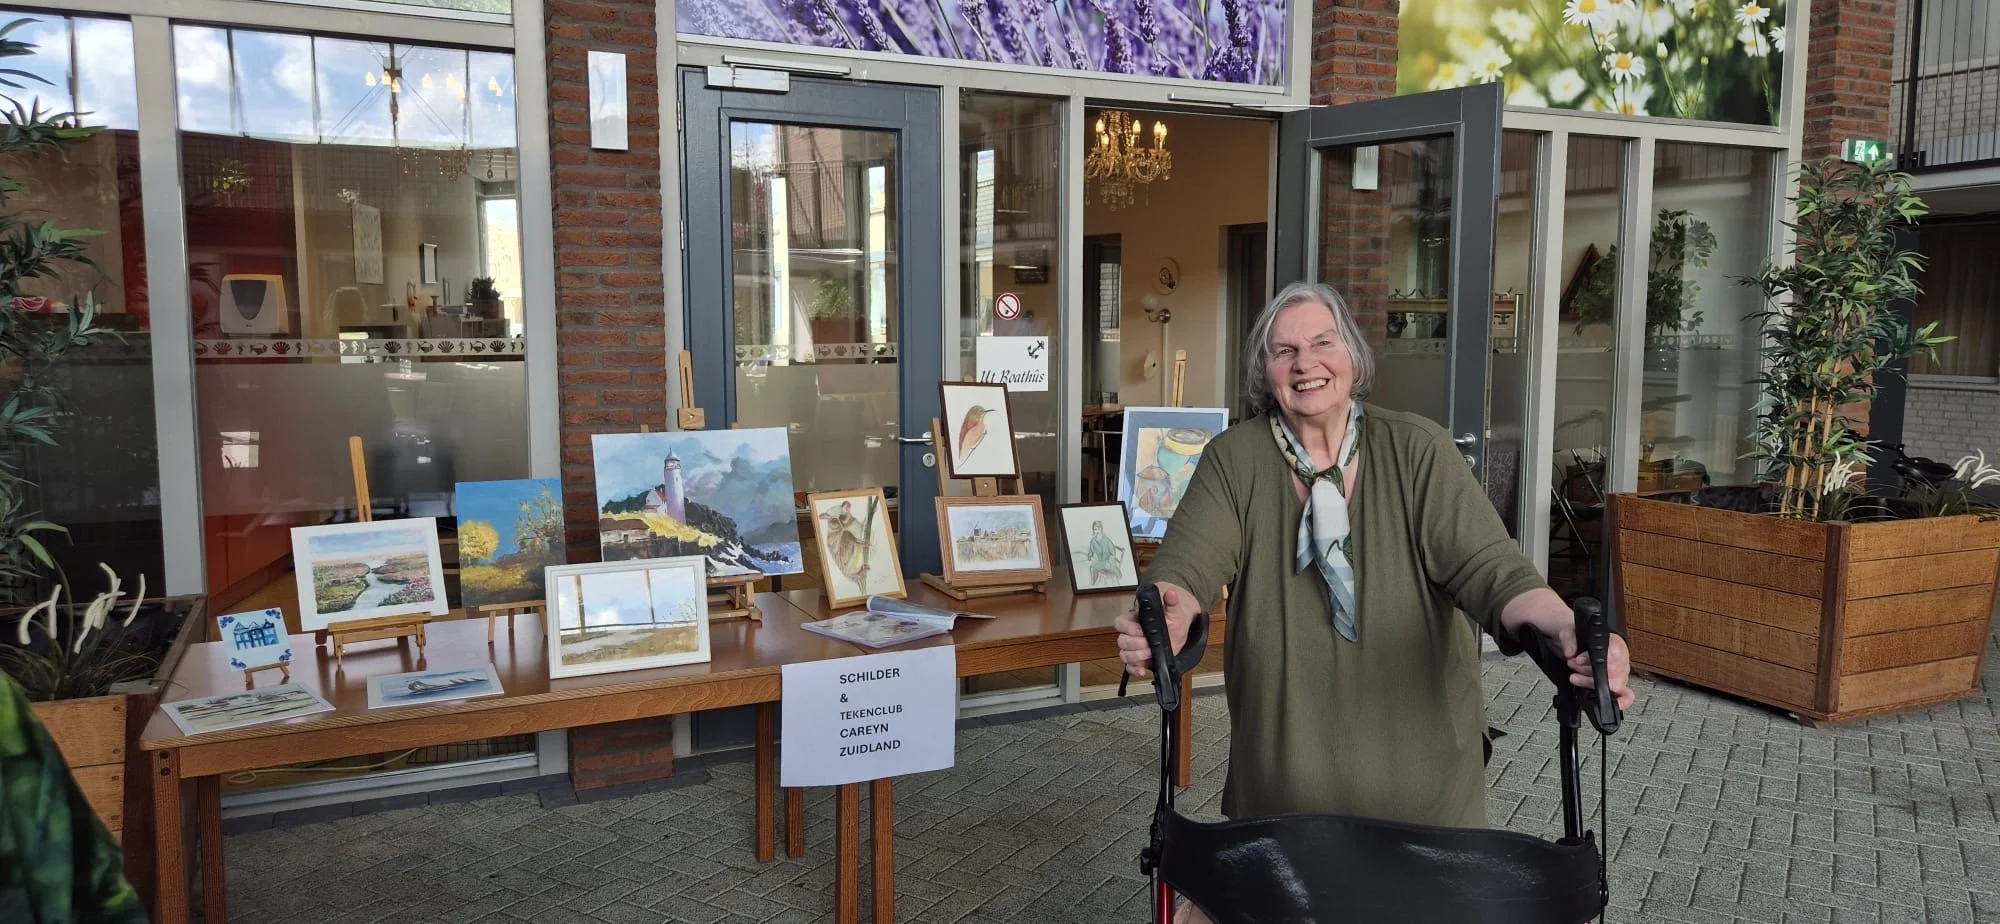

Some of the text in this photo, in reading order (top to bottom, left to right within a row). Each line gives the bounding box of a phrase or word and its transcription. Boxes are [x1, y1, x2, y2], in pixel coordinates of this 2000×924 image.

[839, 668, 900, 684] SCHILDER
[840, 693, 848, 703] &
[840, 704, 902, 720] TEKENCLUB
[840, 723, 889, 738] CAREYN
[839, 740, 901, 757] ZUIDLAND
